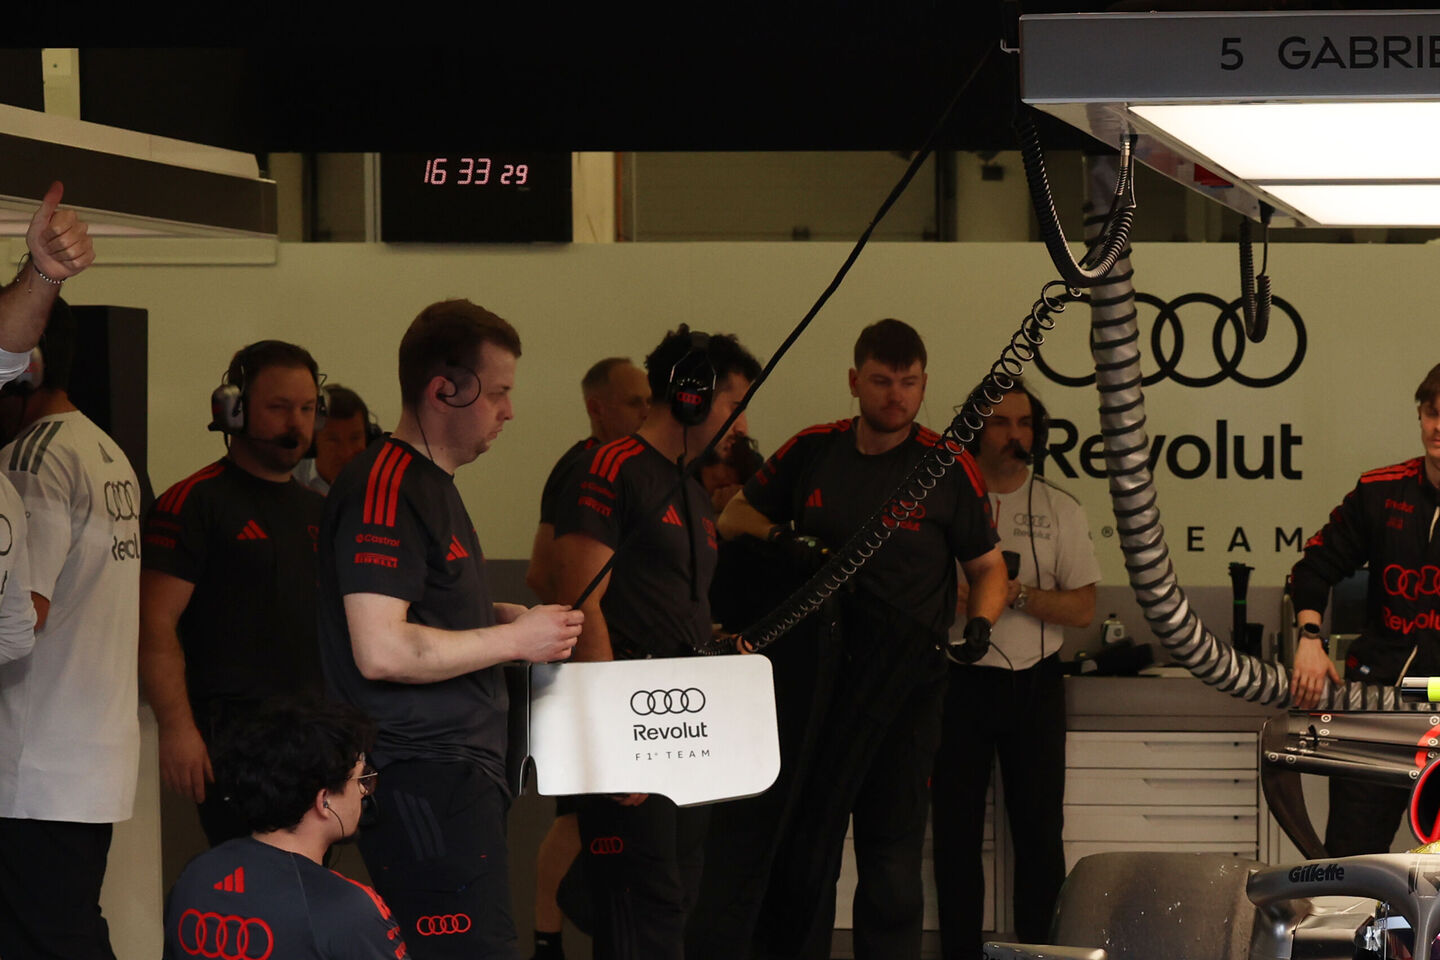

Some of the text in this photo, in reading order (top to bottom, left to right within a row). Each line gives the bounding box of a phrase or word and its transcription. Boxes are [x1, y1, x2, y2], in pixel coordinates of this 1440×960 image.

[1220, 37, 1244, 71] 5
[424, 157, 529, 185] 16 33 29
[632, 721, 709, 742] Revolut
[666, 748, 711, 760] TEAM
[1288, 862, 1346, 884] Gillette
